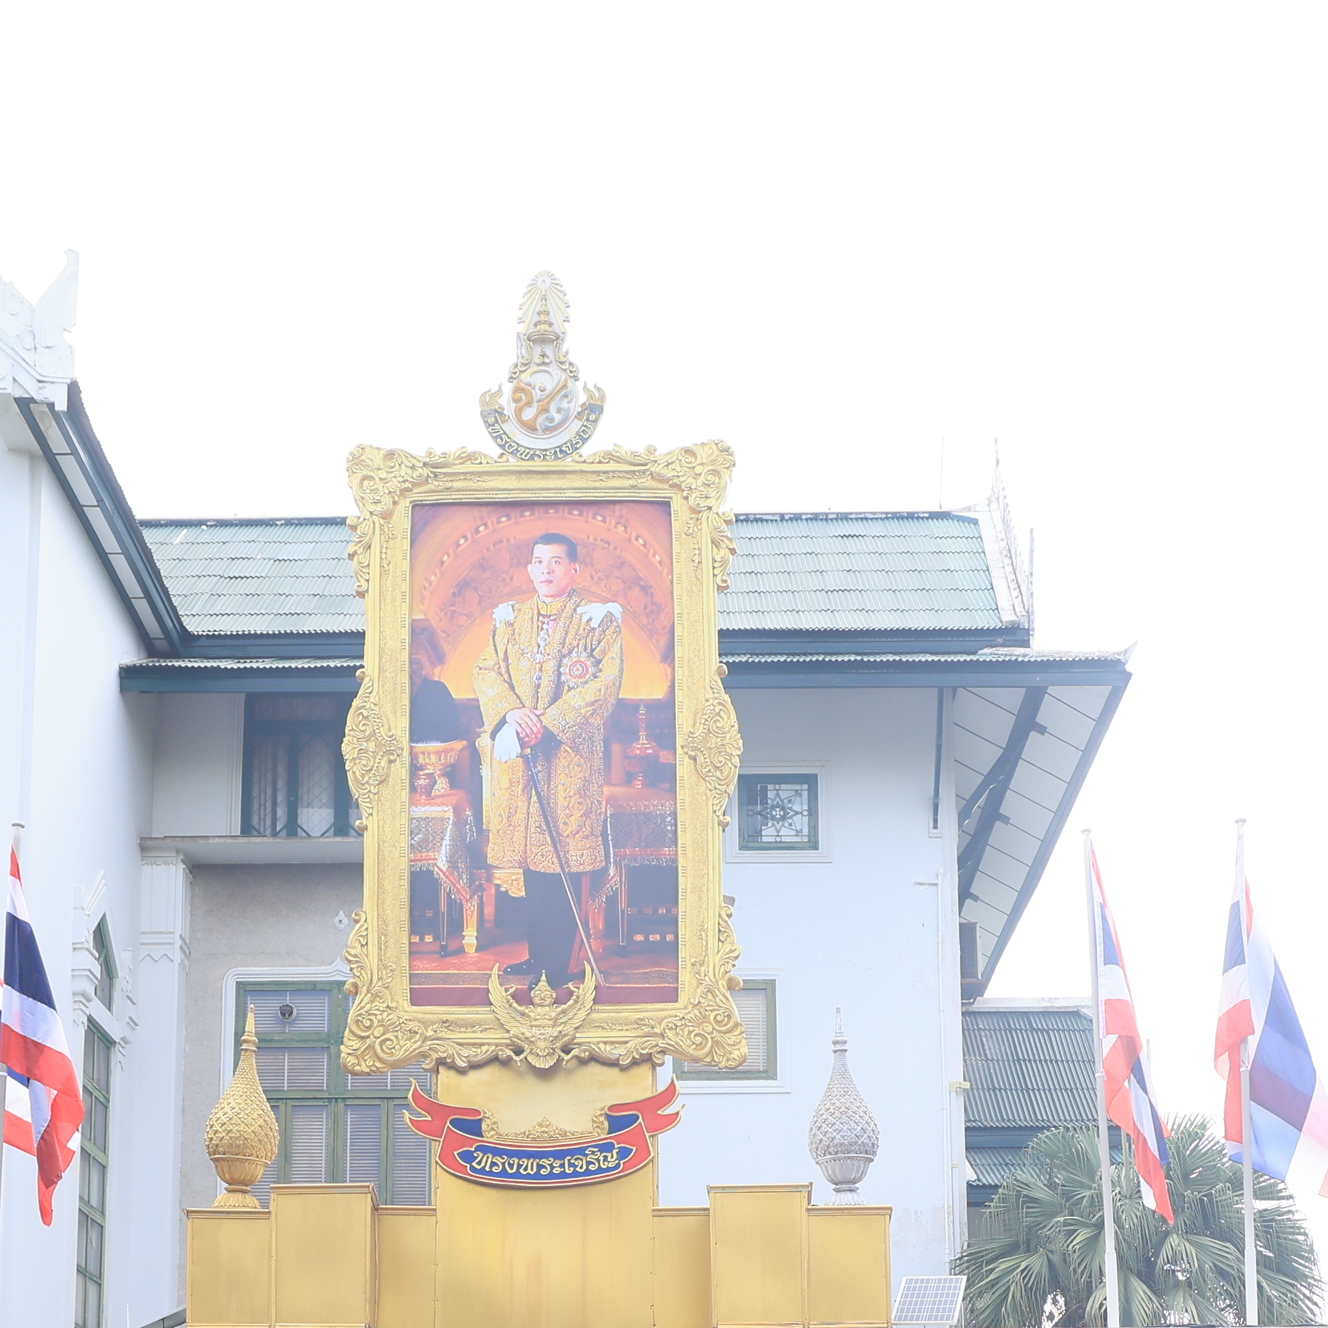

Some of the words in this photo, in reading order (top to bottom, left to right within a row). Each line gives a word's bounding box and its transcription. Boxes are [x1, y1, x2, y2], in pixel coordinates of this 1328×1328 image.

[471, 1147, 620, 1176] ทรงพระเจริญ
